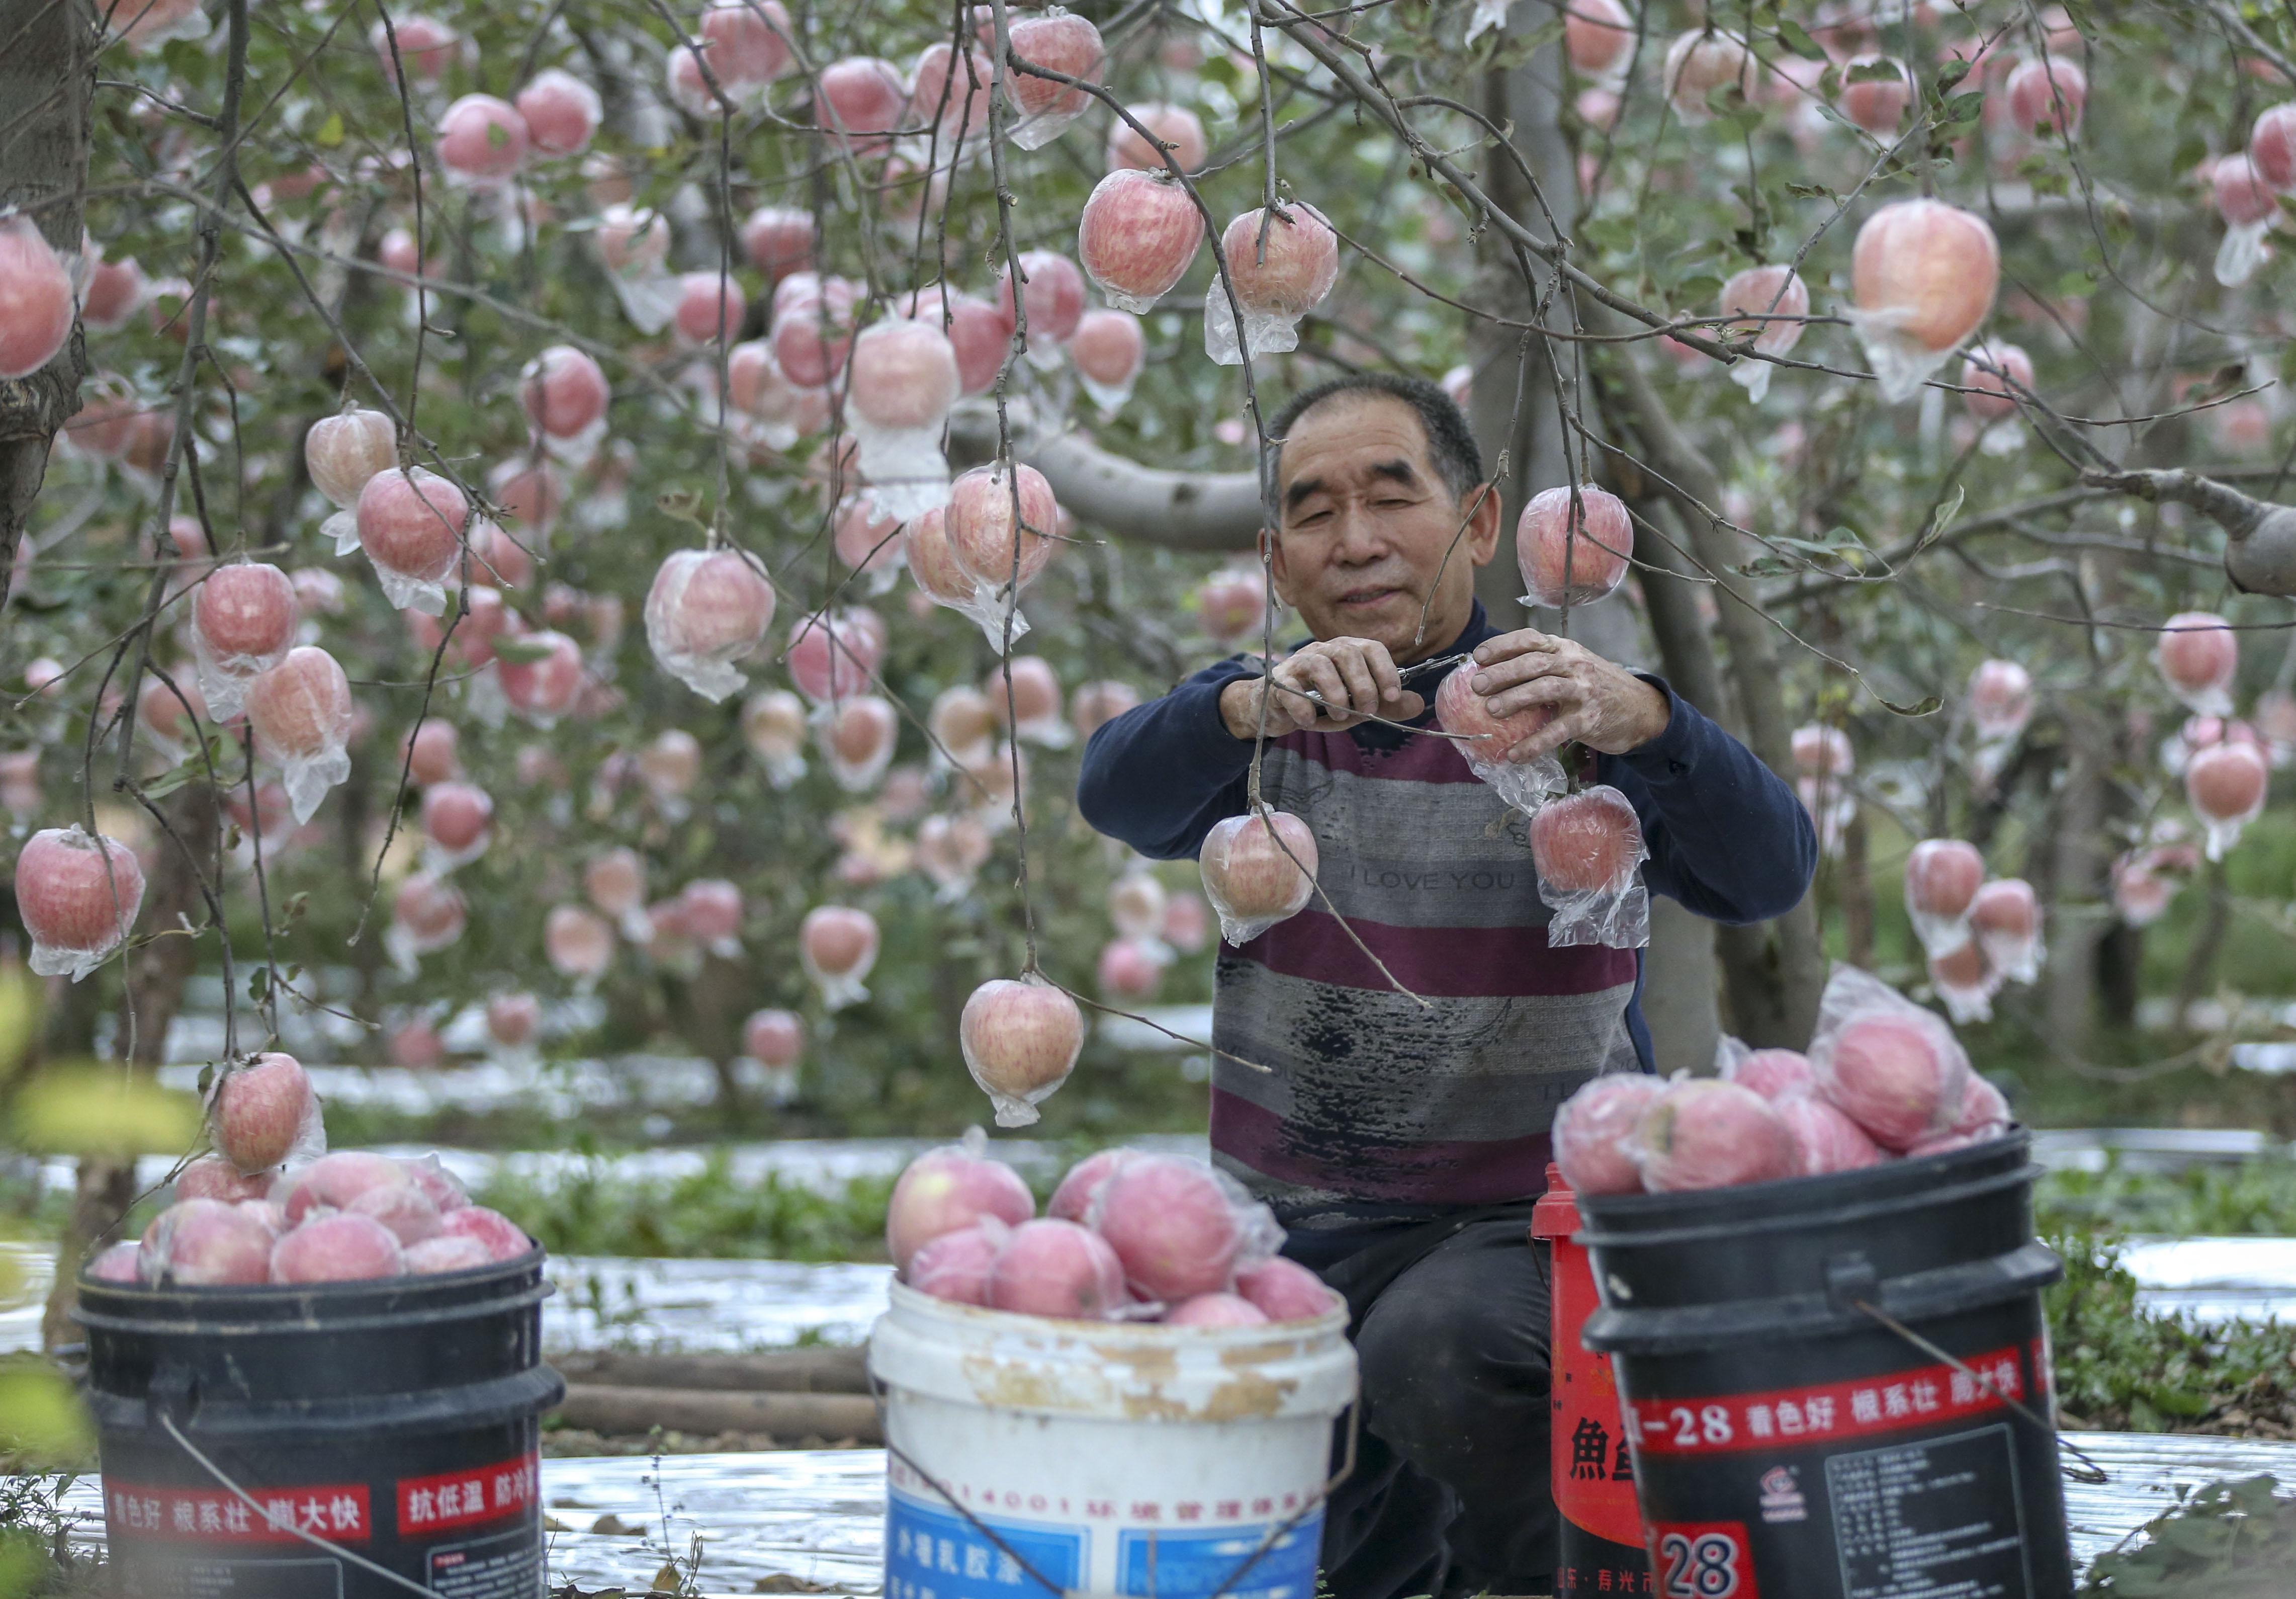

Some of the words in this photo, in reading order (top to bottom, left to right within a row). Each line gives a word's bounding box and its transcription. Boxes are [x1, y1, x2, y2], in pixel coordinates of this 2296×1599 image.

[1364, 869, 1439, 890] LOVE
[1451, 872, 1515, 890] YOU
[1746, 1396, 1835, 1438] 着色好
[1851, 1379, 1938, 1423] 根系壮
[172, 1497, 252, 1533] 根系壮
[409, 1479, 486, 1523] 抗低温
[1661, 1532, 1740, 1598] 28
